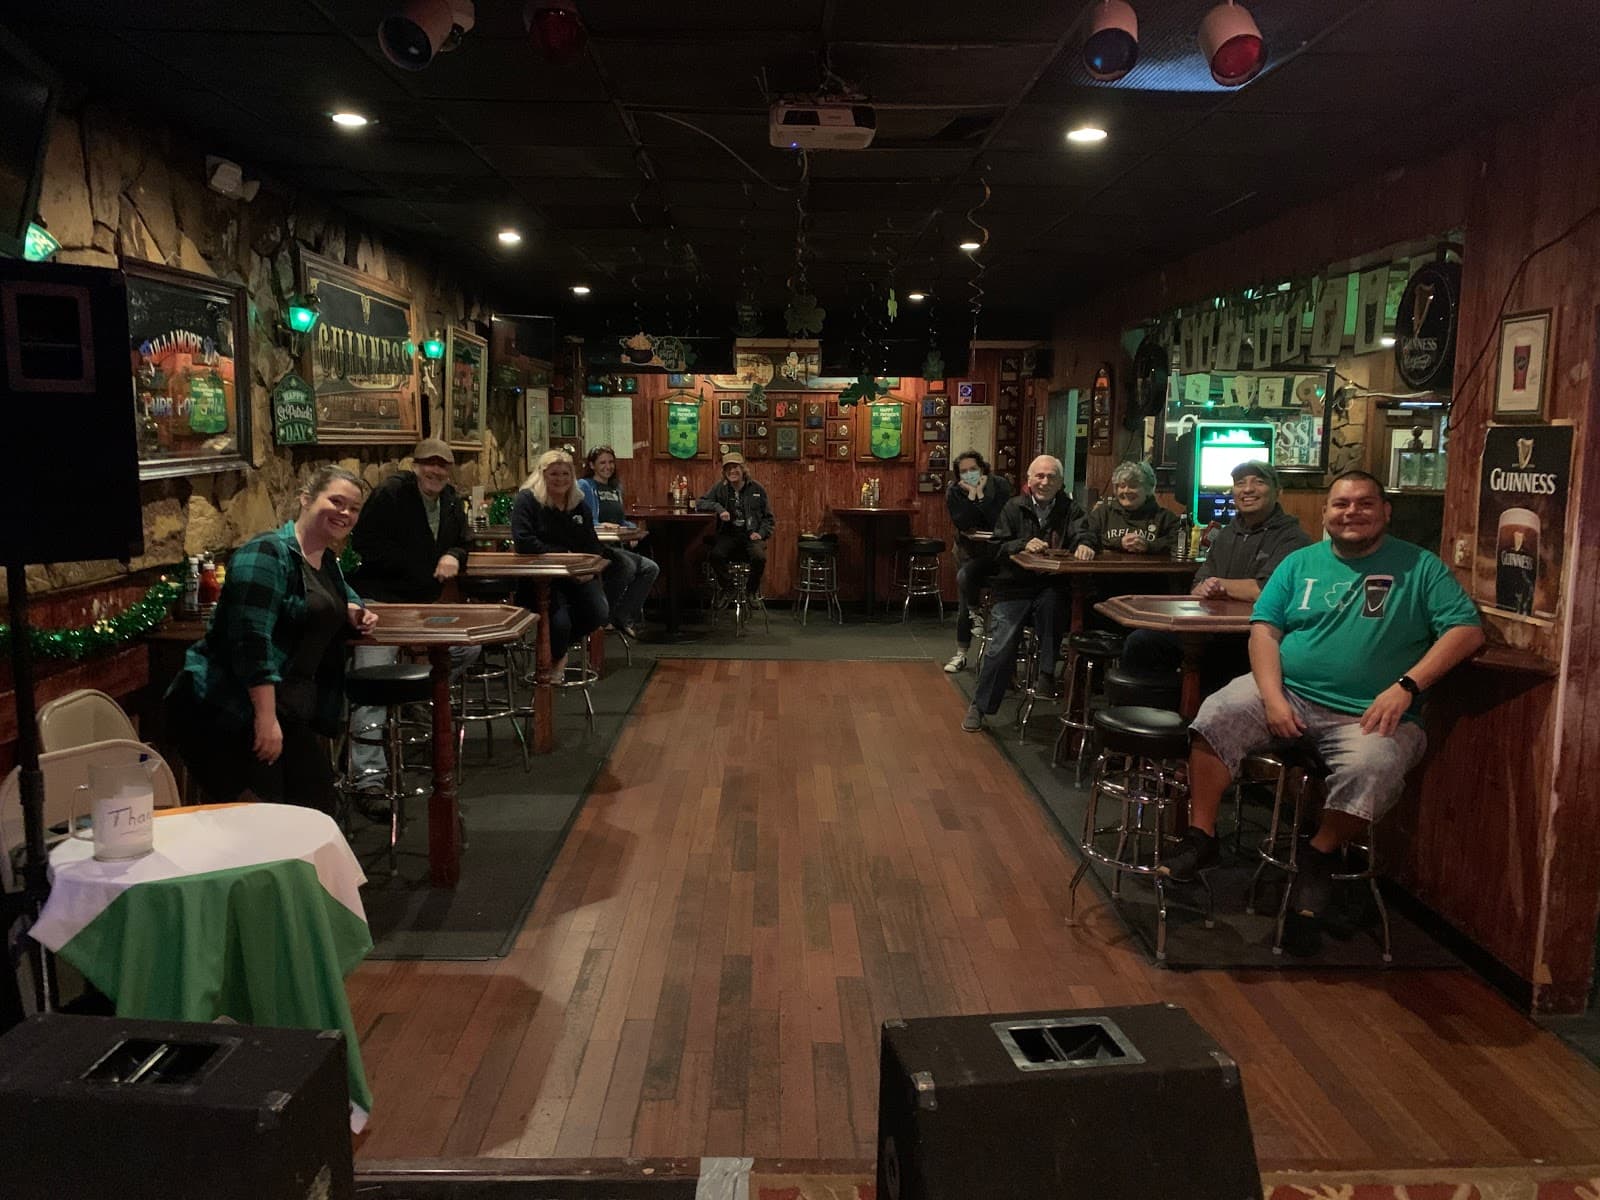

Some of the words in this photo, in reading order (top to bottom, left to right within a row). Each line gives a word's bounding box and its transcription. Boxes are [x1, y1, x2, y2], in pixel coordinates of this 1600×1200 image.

[318, 321, 411, 380] GUINNESS
[285, 423, 306, 441] DAY
[1490, 467, 1559, 495] GUINNESS
[1501, 550, 1535, 570] GUINNESS
[1297, 577, 1319, 610] I
